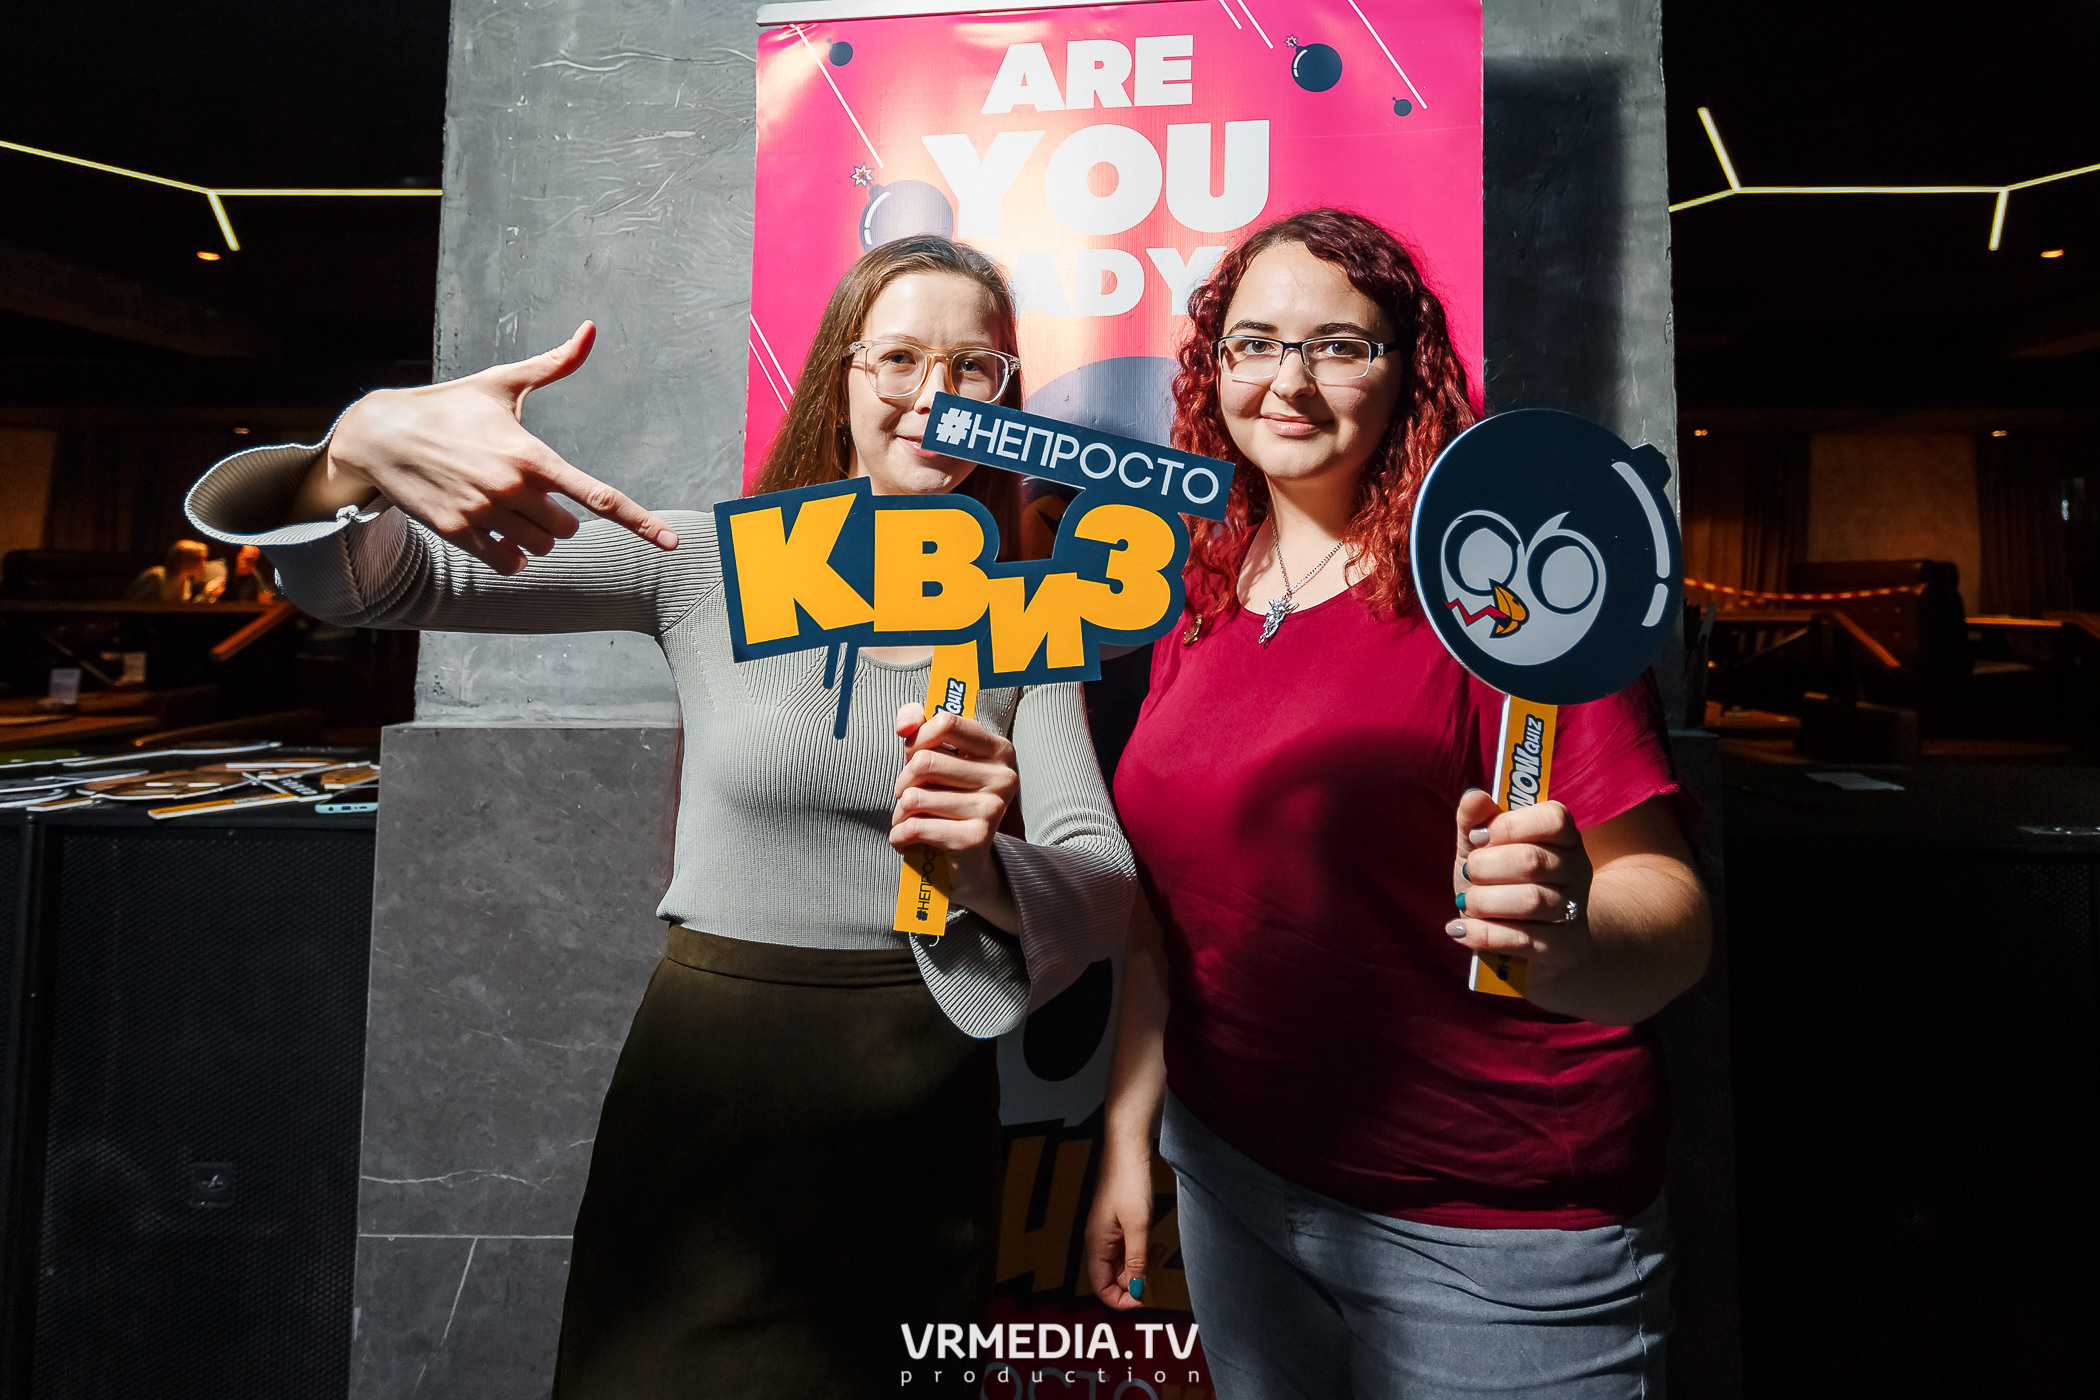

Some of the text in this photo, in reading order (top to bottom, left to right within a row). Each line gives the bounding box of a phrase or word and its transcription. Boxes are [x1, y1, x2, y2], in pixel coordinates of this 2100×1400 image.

[982, 34, 1194, 114] ARE
[921, 120, 1270, 239] YOU
[1007, 246, 1228, 318] ADY
[936, 407, 1219, 504] #НЕПРОСТО
